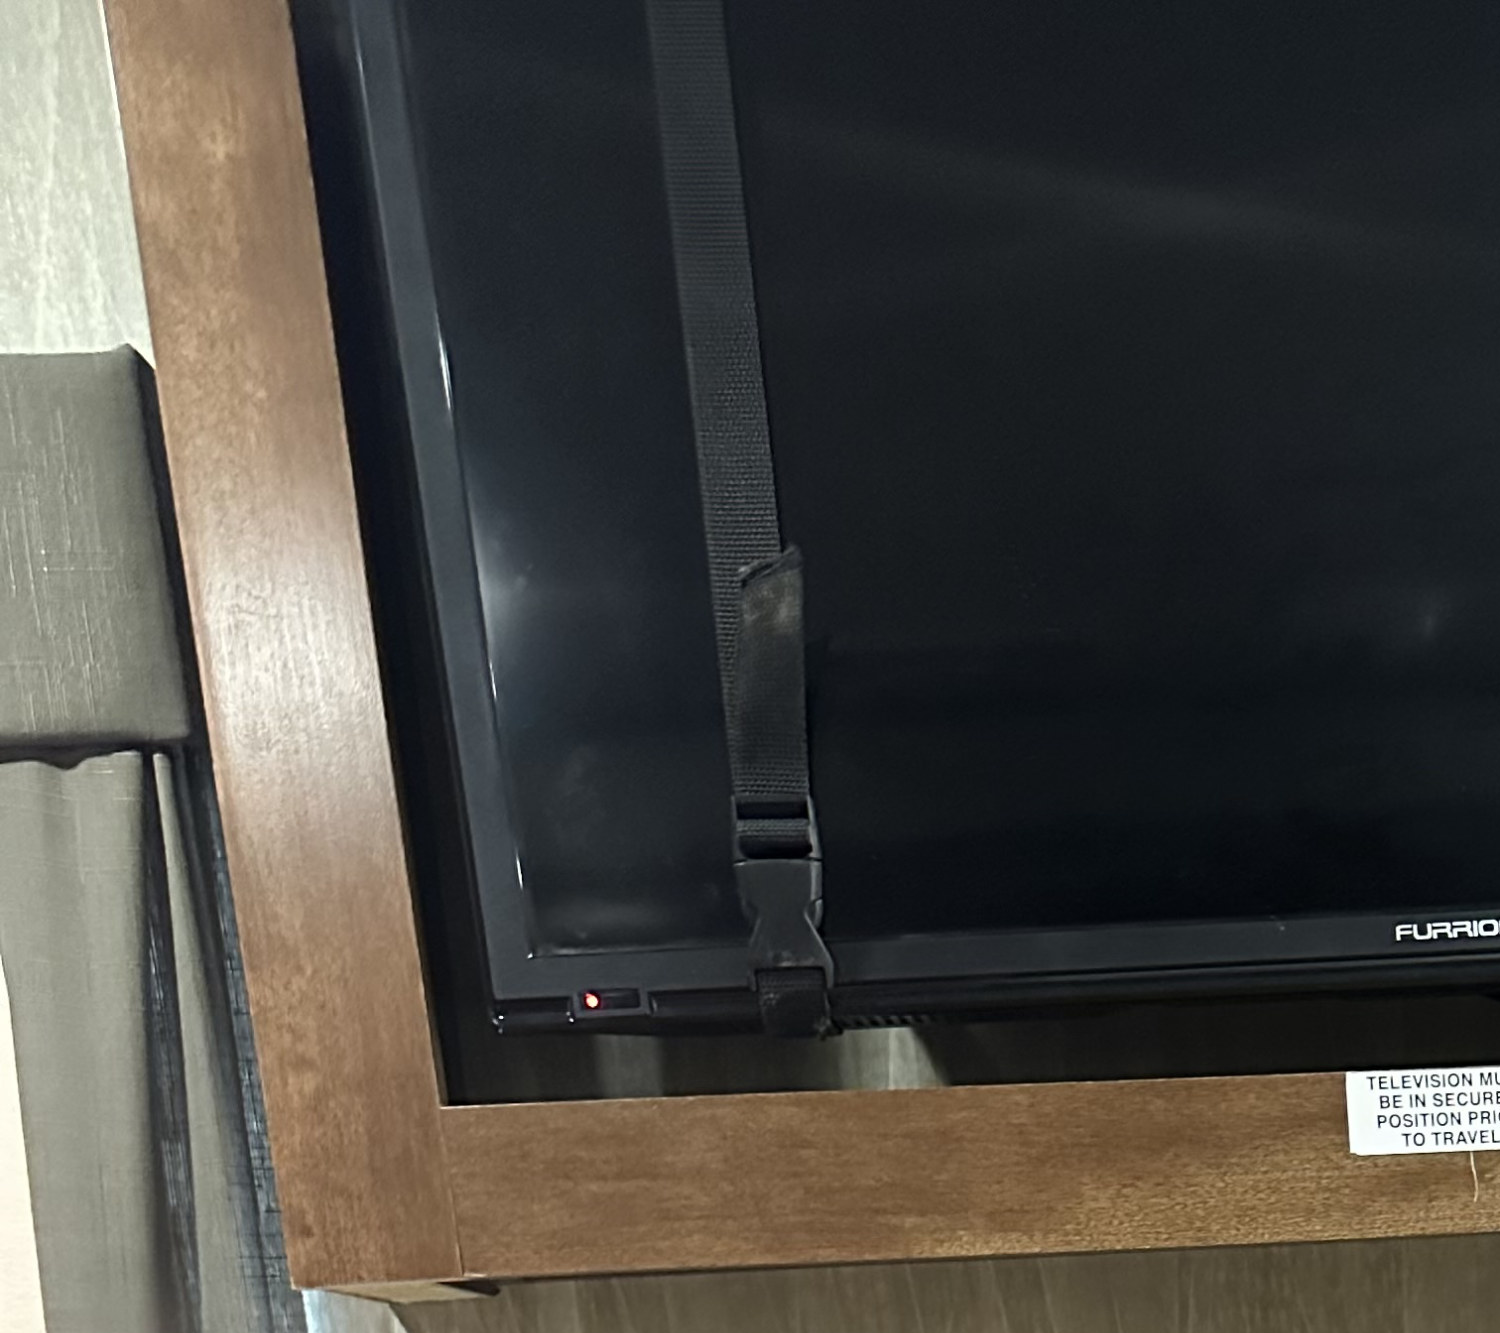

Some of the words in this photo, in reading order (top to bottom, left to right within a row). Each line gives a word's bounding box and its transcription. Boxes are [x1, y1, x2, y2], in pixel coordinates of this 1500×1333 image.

[1366, 1073, 1473, 1090] TELEVISION
[1379, 1095, 1403, 1109] BE
[1409, 1093, 1427, 1108] IN
[1377, 1112, 1462, 1129] POSITION
[1401, 1132, 1426, 1147] TO
